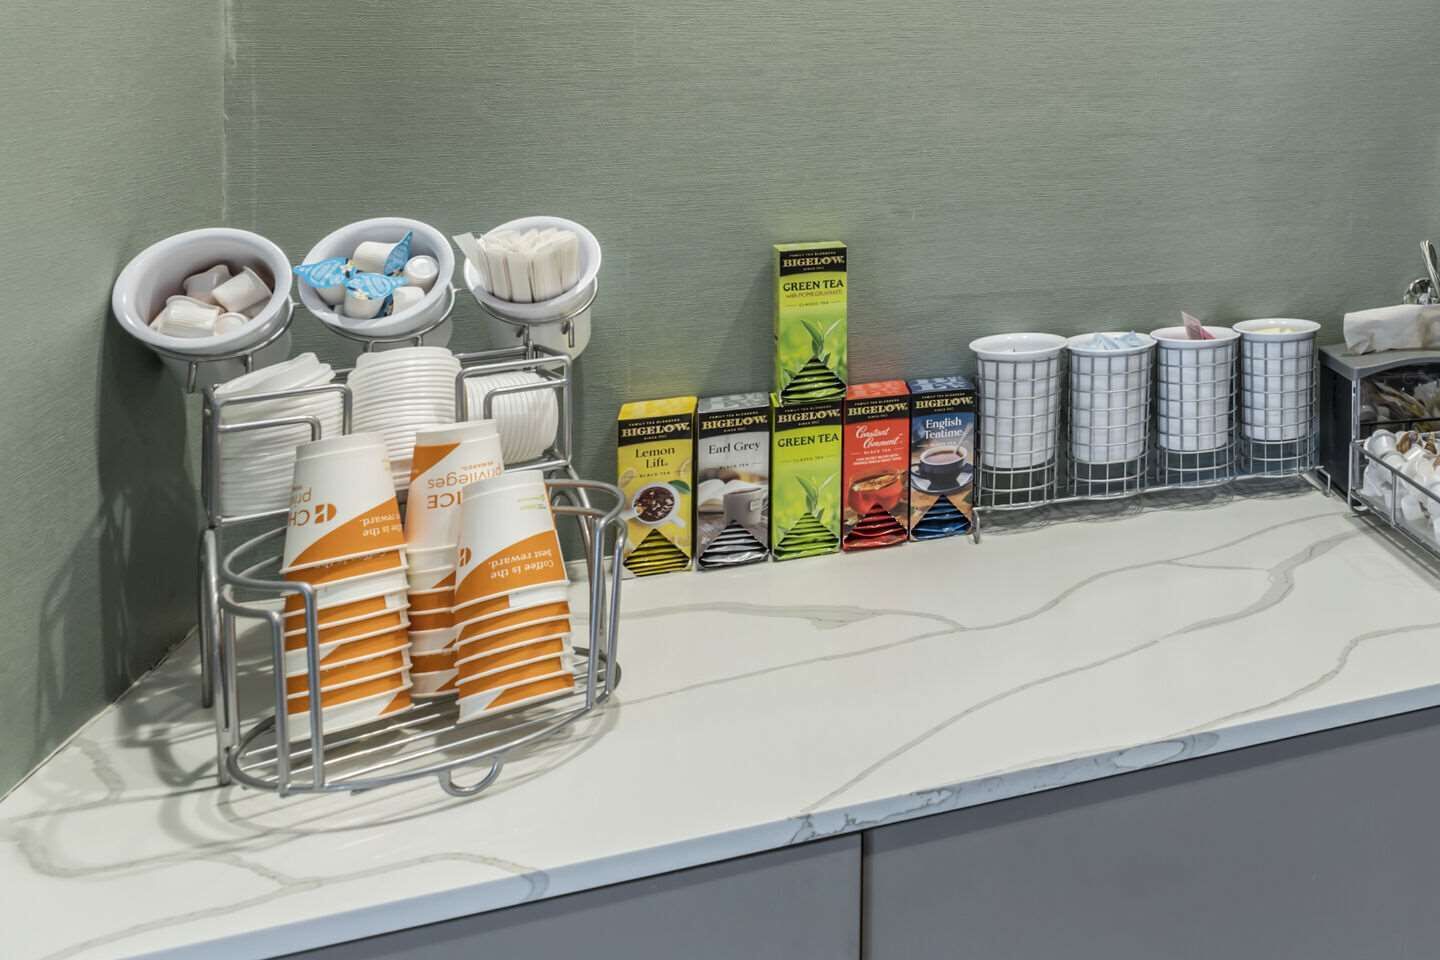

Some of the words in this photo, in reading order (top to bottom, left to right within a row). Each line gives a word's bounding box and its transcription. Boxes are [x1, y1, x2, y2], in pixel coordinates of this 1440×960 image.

[783, 256, 845, 267] BIGELOW
[783, 280, 820, 292] GREEN
[823, 279, 844, 289] TEA
[847, 402, 908, 416] BIGELOW
[916, 396, 974, 409] BIGELOW
[702, 415, 768, 430] BIGELOW
[777, 409, 841, 423] BIGELOW
[622, 421, 690, 437] BIGELOW
[925, 416, 962, 430] English
[777, 435, 815, 448] GREEN
[818, 433, 839, 443] TEA
[925, 429, 963, 440] Teatime
[635, 447, 675, 458] Lemon
[708, 442, 731, 455] Earl
[733, 440, 760, 452] Grey
[645, 457, 664, 469] Lift
[362, 524, 380, 537] the
[488, 552, 530, 568] reward.
[523, 559, 554, 574] Coffee
[490, 569, 509, 579] the
[511, 565, 522, 576] is
